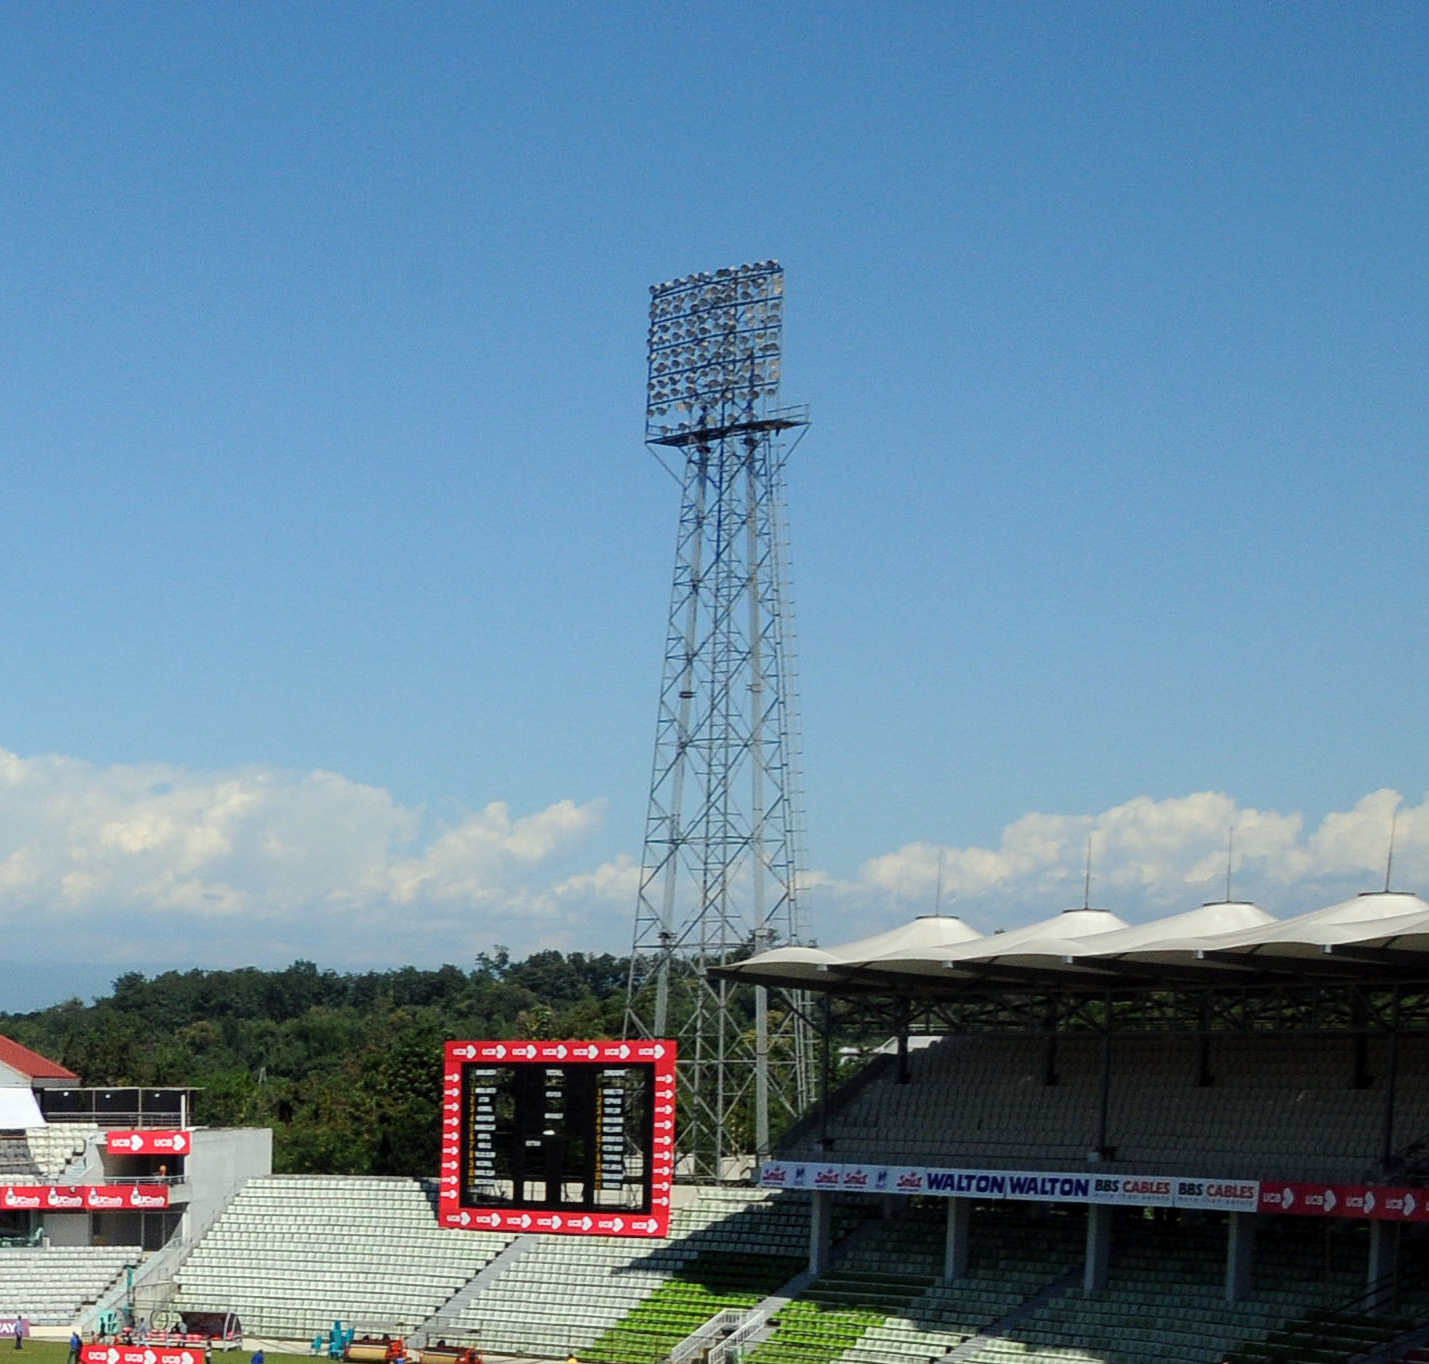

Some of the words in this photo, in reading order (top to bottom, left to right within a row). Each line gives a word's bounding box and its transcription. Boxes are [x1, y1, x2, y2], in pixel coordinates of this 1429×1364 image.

[112, 1139, 131, 1148] UCB
[154, 1139, 173, 1147] UCB
[927, 1173, 1005, 1193] WALTON
[1009, 1176, 1089, 1197] WALTON
[1095, 1179, 1119, 1192] BBS
[1122, 1180, 1170, 1194] CABLES
[1178, 1183, 1203, 1195] BBS
[1206, 1184, 1254, 1198] CABLES
[88, 1351, 107, 1360] UCB
[125, 1354, 144, 1363] UCB
[161, 1356, 180, 1364] UCB
